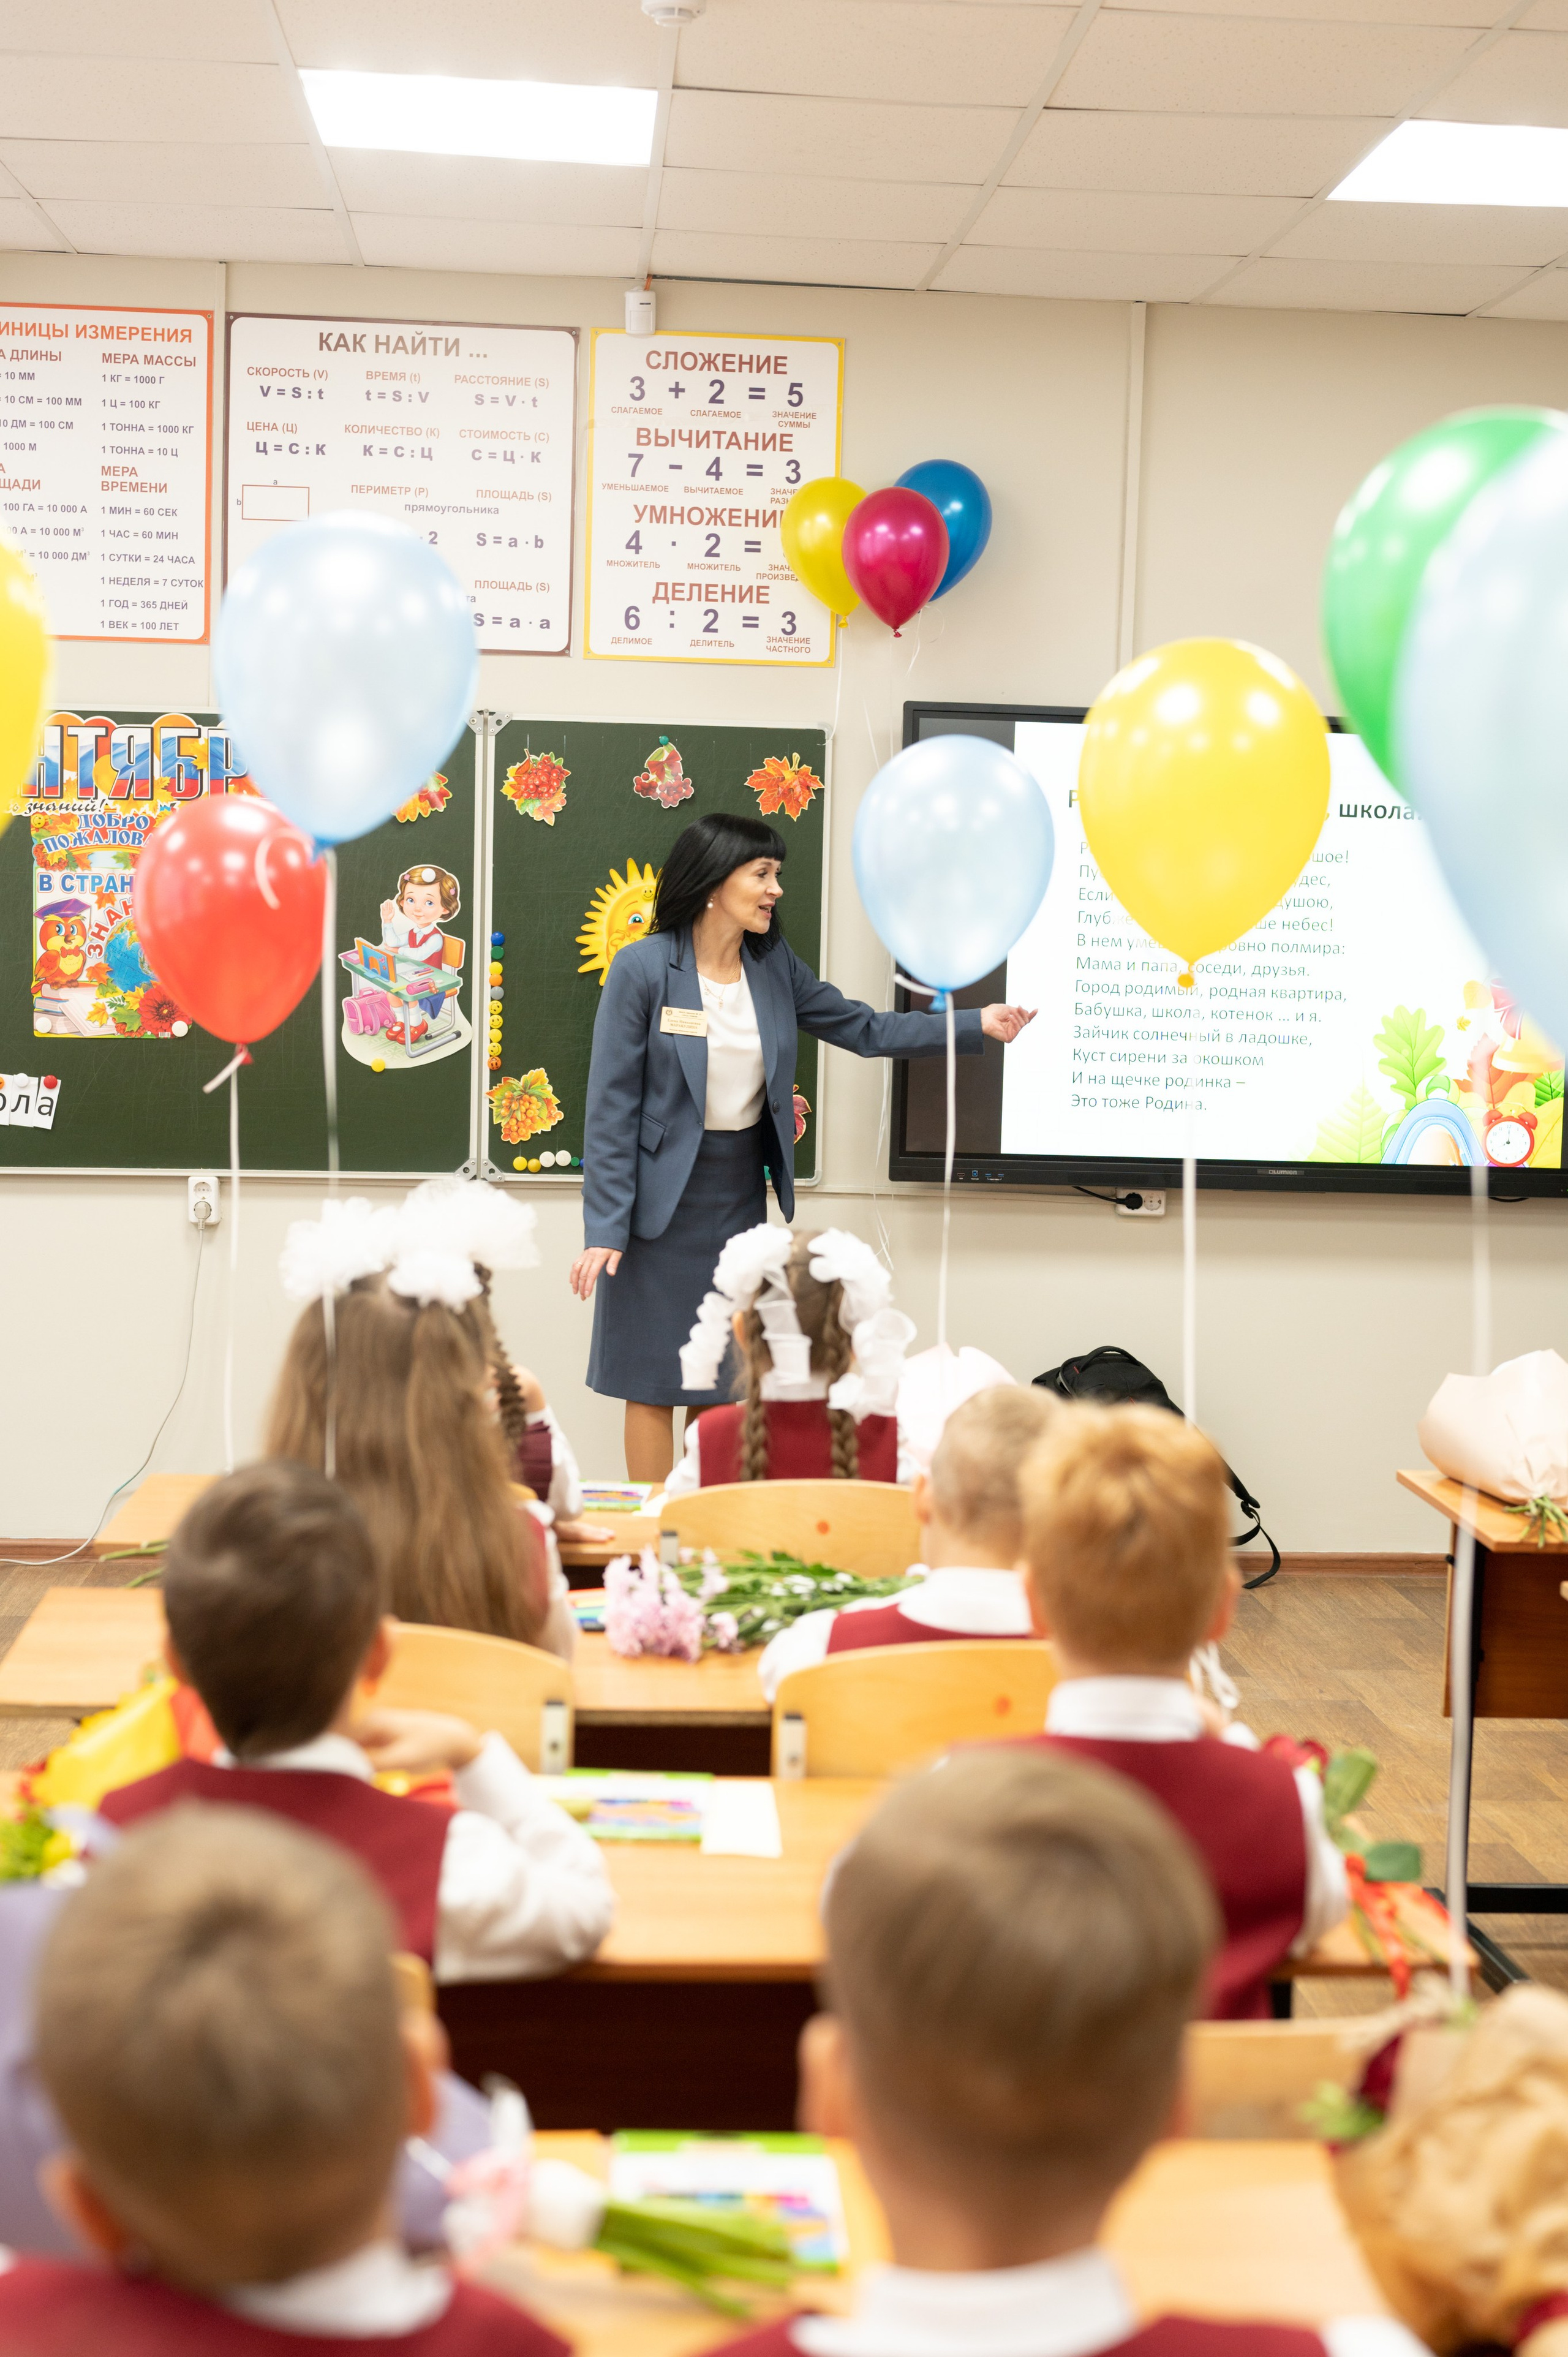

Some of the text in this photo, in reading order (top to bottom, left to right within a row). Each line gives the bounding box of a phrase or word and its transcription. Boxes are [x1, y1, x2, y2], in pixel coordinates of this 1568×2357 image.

[76, 325, 192, 343] ИЗМЕРЕНИЯ
[319, 333, 366, 352] КАК
[375, 331, 459, 356] НАЙТИ
[10, 350, 61, 361] ДЛИНЫ
[102, 353, 195, 367] МЕРА МАССЫ
[646, 350, 787, 374] СЛОЖЕНИЕ
[247, 367, 309, 377] СКОРОСТЬ
[366, 371, 405, 381] ВРЕМЯ
[134, 375, 156, 384] 1000
[455, 375, 530, 386] РАССТОЯНИЕ
[630, 376, 645, 401] 3
[709, 379, 725, 404] 2
[788, 383, 803, 407] 5
[110, 399, 117, 409] Ц
[110, 423, 145, 432] ТОННА
[247, 421, 297, 434] ЦЕНА (Ц)
[345, 424, 422, 436] КОЛИЧЕСТВО
[459, 429, 530, 440] СТОИМОСТЬ
[637, 428, 793, 452] ВЫЧИТАНИЕ
[102, 466, 138, 477] МЕРА
[102, 481, 167, 493] ВРЕМЕНИ
[352, 485, 410, 495] ПЕРИМЕТР
[602, 483, 668, 492] УМЕНЬШАЕМОЕ
[684, 486, 743, 495] ВЫЧИТАЕМОЕ
[477, 489, 534, 501] ПЛОЩАДЬ
[405, 505, 499, 515] прямоугольника
[633, 504, 781, 529] УМНОЖЕНИ
[110, 577, 150, 586] НЕДЕЛЯ
[170, 579, 203, 588] СУТОК
[756, 573, 800, 582] ПРОИЗВЕ
[475, 580, 532, 592] ПЛОЩАДЬ
[652, 582, 769, 604] ДЕЛЕНИЕ
[109, 600, 129, 609] ГОД
[160, 600, 187, 610] ДНЕЙ
[21, 725, 248, 802] НТЯБР
[24, 798, 106, 815] знаний!
[1340, 804, 1422, 820] школа
[78, 814, 149, 830] ДОБРО
[43, 830, 151, 852] ПОЖАЛОВ
[39, 874, 134, 892] В СТРАН
[87, 900, 134, 958] ЗНАН
[1283, 918, 1333, 931] небес!
[1077, 933, 1085, 946] В
[1091, 937, 1121, 947] нем
[1272, 943, 1344, 957] полмира:
[1077, 957, 1121, 970] Мама
[1127, 962, 1135, 970] и
[1251, 963, 1310, 979] друзья.
[1075, 979, 1120, 997] Город
[1209, 985, 1265, 1000] родная
[1271, 987, 1347, 1003] квартира,
[1074, 1003, 1147, 1020] Бабушка,
[1211, 1008, 1273, 1022] котенок
[1295, 1011, 1304, 1023] и
[1309, 1011, 1322, 1024] я.
[1073, 1025, 1129, 1041] Зайчик
[1226, 1031, 1233, 1043] в
[1238, 1032, 1313, 1047] ладошке,
[1073, 1048, 1105, 1065] Куст
[1110, 1051, 1166, 1066] сирени
[1172, 1052, 1187, 1065] за
[1072, 1071, 1083, 1085] И
[1088, 1073, 1105, 1086] на
[1111, 1074, 1159, 1089] щечке
[1071, 1094, 1097, 1109] Это
[1101, 1096, 1139, 1109] тоже
